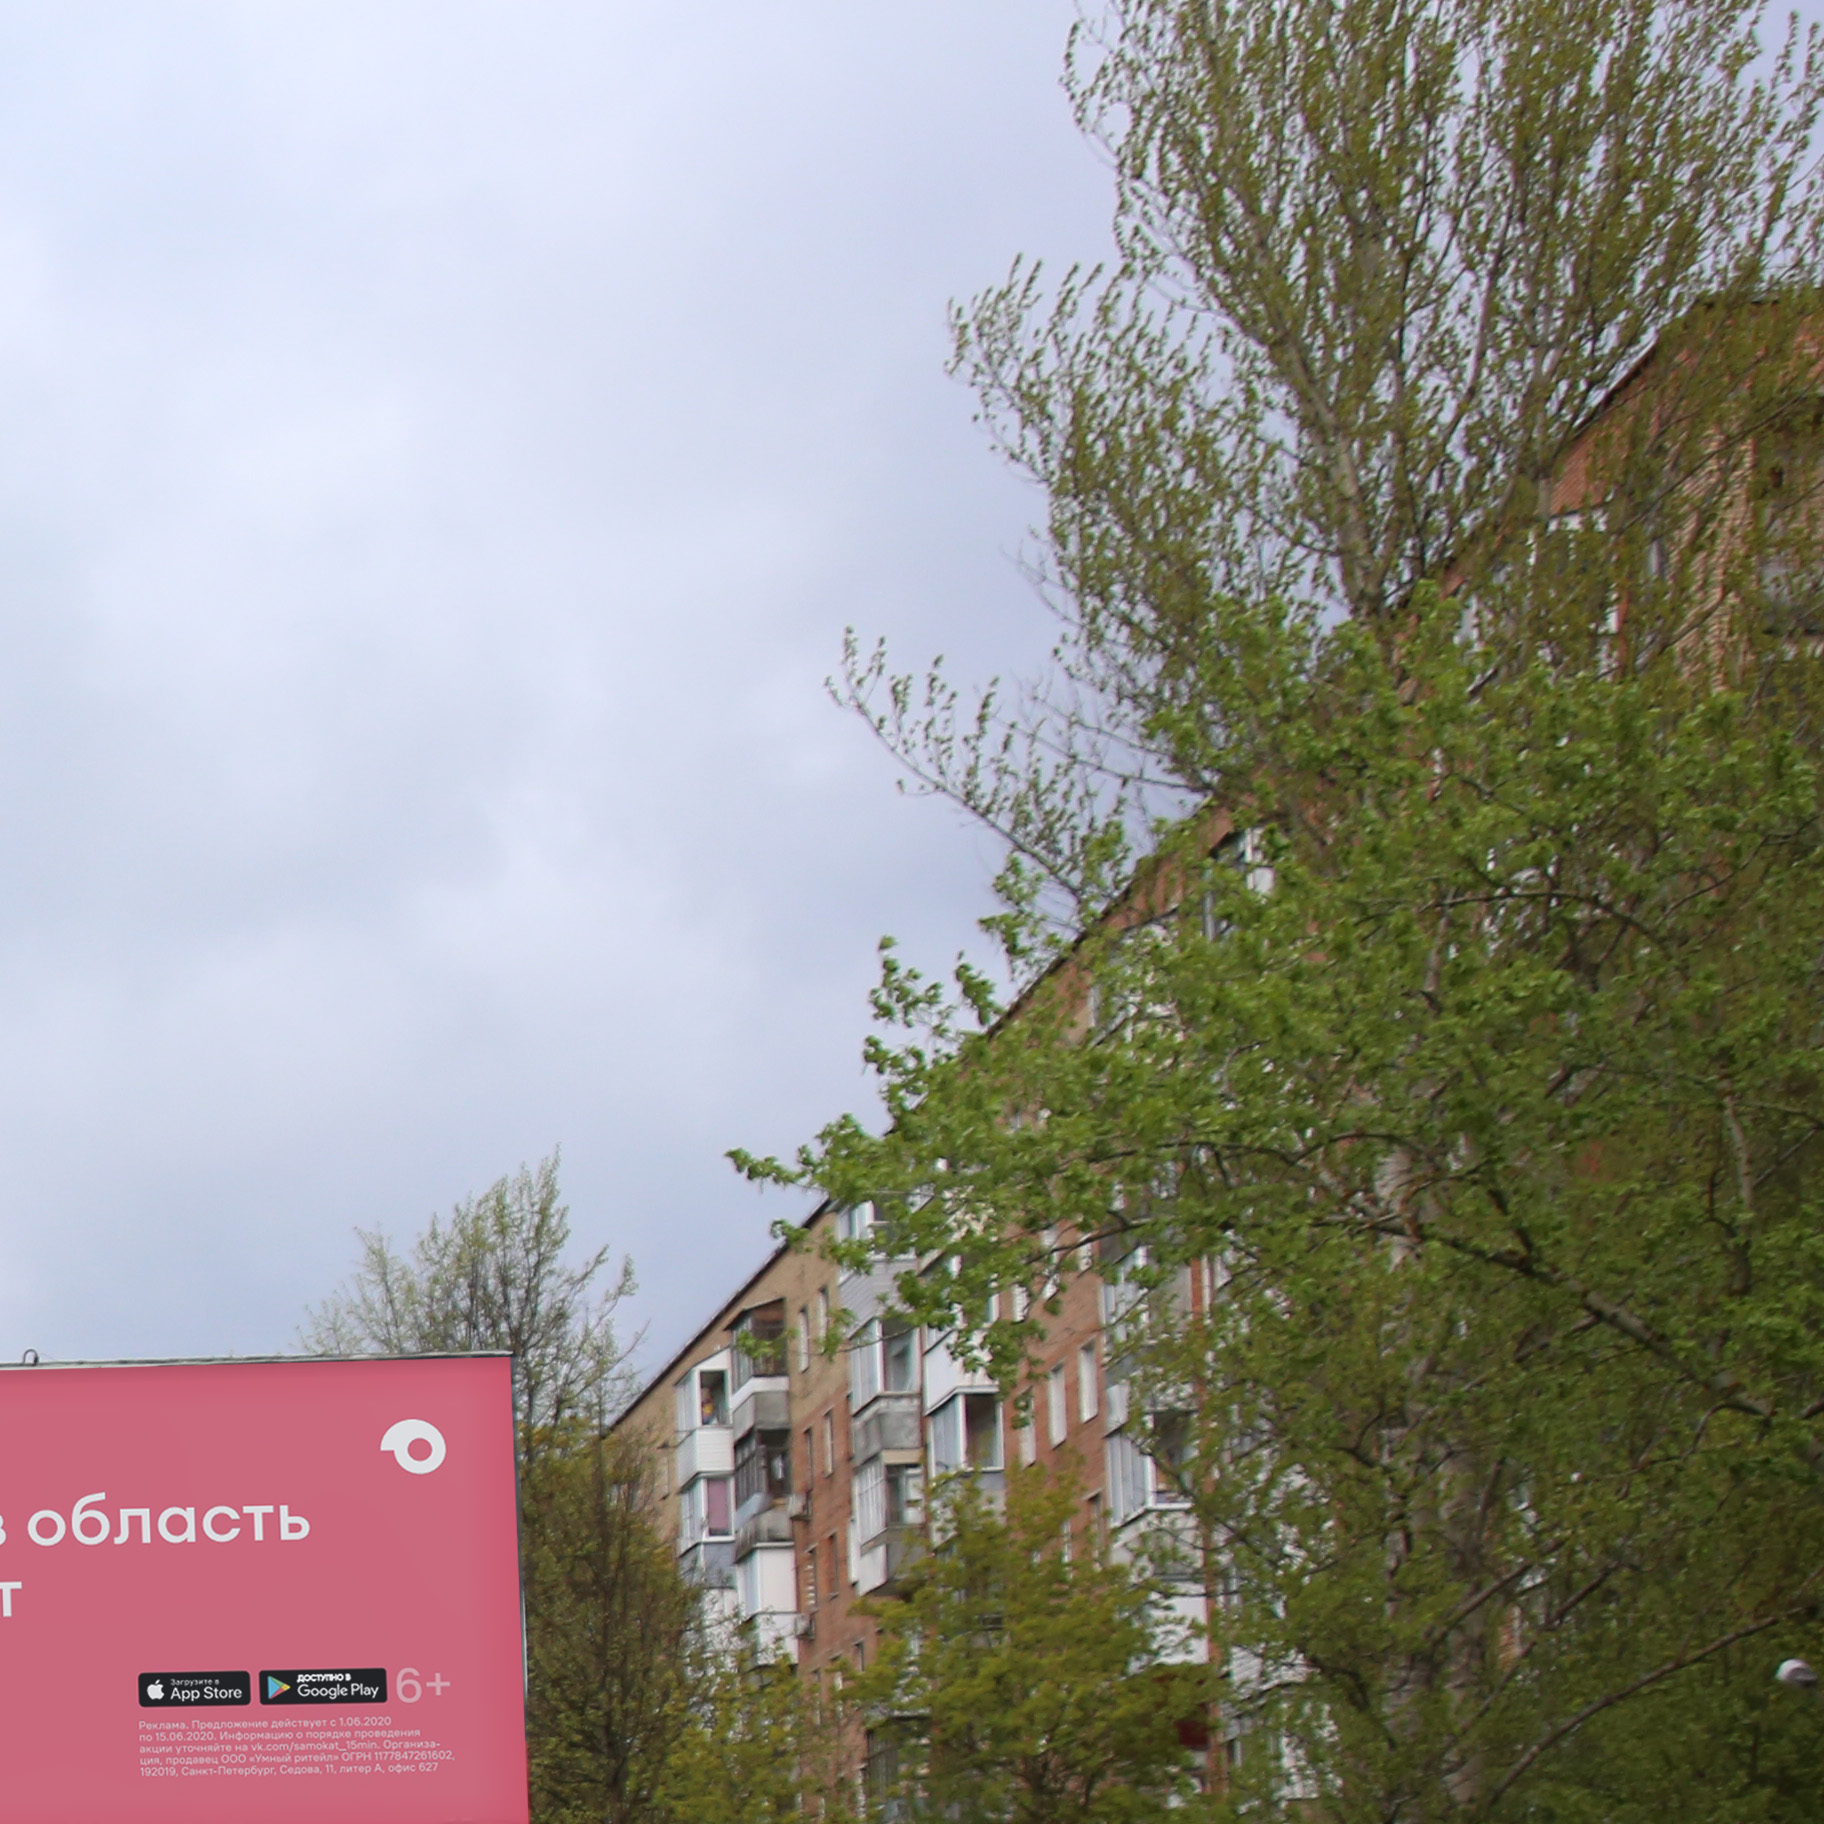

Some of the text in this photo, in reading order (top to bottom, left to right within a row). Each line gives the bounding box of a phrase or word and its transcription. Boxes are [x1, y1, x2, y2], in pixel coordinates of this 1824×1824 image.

[26, 1491, 313, 1549] область
[170, 1679, 212, 1687] Загрузите
[396, 1667, 451, 1703] 6+
[170, 1686, 243, 1702] App Store
[297, 1683, 380, 1700] Google Play
[138, 1720, 190, 1730] Реклама.
[192, 1719, 269, 1730] Предложение
[271, 1718, 328, 1729] действует
[339, 1716, 392, 1726] 1.06.2020
[139, 1734, 153, 1742] по
[155, 1731, 217, 1742] 15.06.2020.
[219, 1731, 294, 1742] Информацию
[305, 1730, 352, 1740] порядке
[354, 1728, 421, 1738] проведения
[139, 1745, 173, 1754] акции
[175, 1743, 232, 1755] уточняйте
[165, 1755, 219, 1766] продавец
[221, 1754, 247, 1764] ООО
[342, 1751, 372, 1761] ОГРН
[181, 1765, 277, 1777] Санкт-Петербург,
[339, 1766, 372, 1775] литер
[388, 1763, 416, 1773] офис
[418, 1762, 439, 1772] 627
